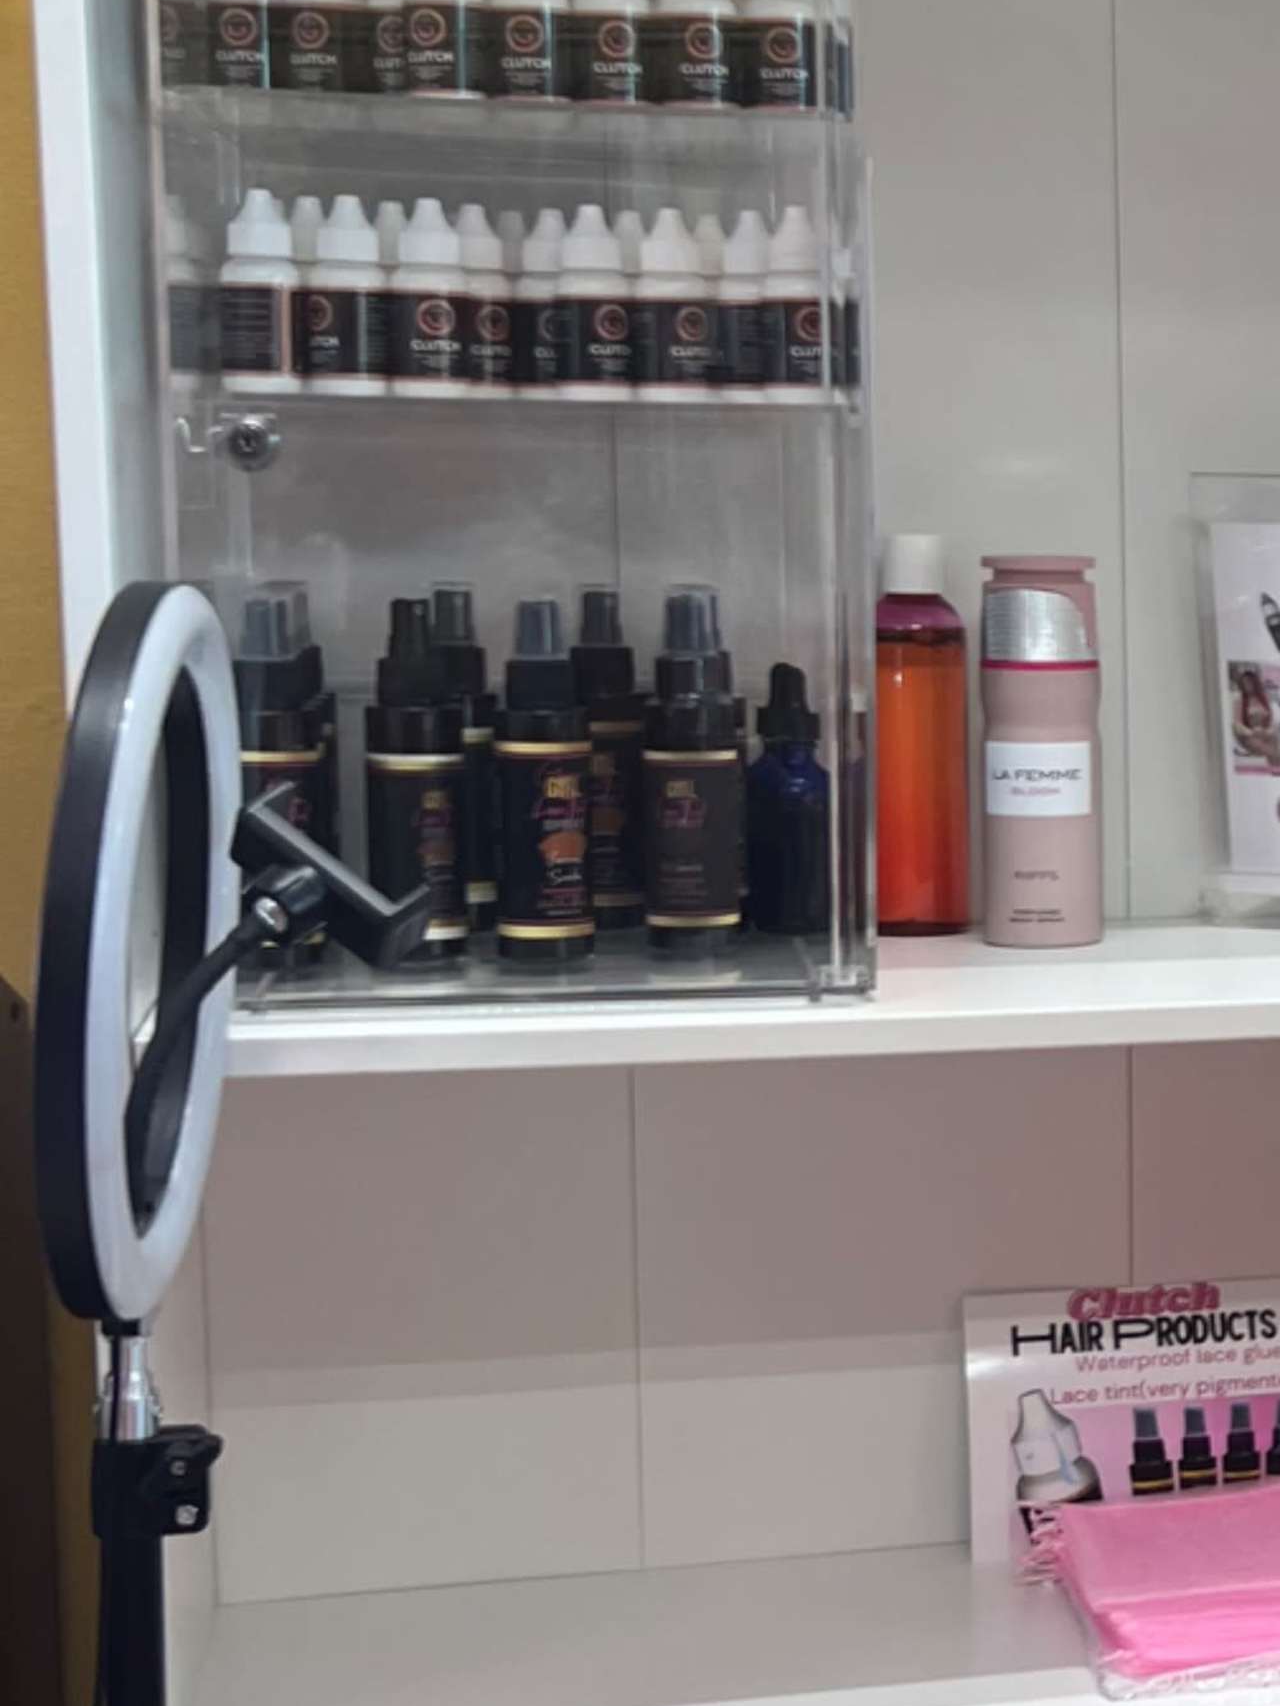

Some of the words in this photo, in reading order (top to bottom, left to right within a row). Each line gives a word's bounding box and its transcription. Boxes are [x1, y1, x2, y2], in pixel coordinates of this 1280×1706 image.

[992, 769, 1010, 780] LA
[1014, 768, 1082, 781] FEMME
[1068, 1281, 1221, 1322] Clutch
[1075, 1349, 1191, 1373] Waterproof
[1197, 1346, 1237, 1364] lace
[1051, 1387, 1098, 1406] Lace
[1105, 1377, 1191, 1403] tint(very
